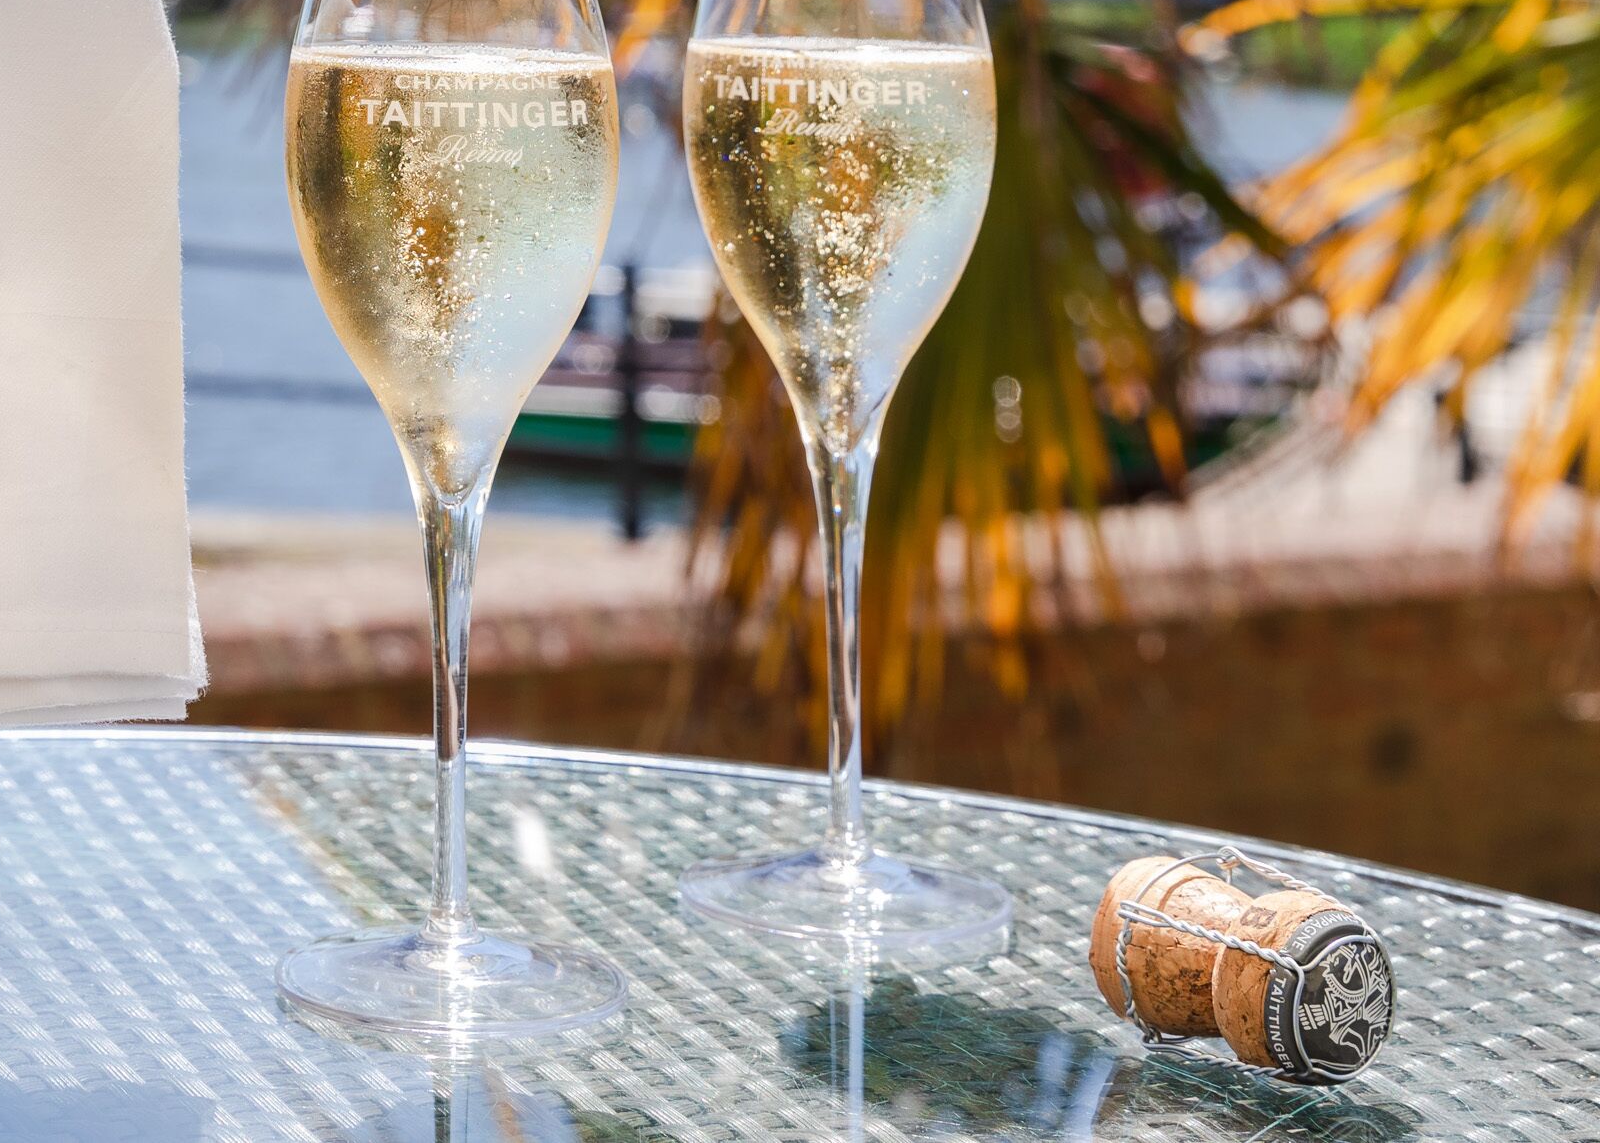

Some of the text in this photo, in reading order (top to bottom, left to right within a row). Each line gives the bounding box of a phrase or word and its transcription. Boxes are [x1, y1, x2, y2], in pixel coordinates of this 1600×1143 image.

[395, 74, 561, 91] CHAMPAGNE
[713, 73, 928, 107] TAITTINGER
[359, 98, 589, 128] TAITTINGER
[426, 134, 524, 164] Reims
[1268, 977, 1295, 1070] TAITTINGER
